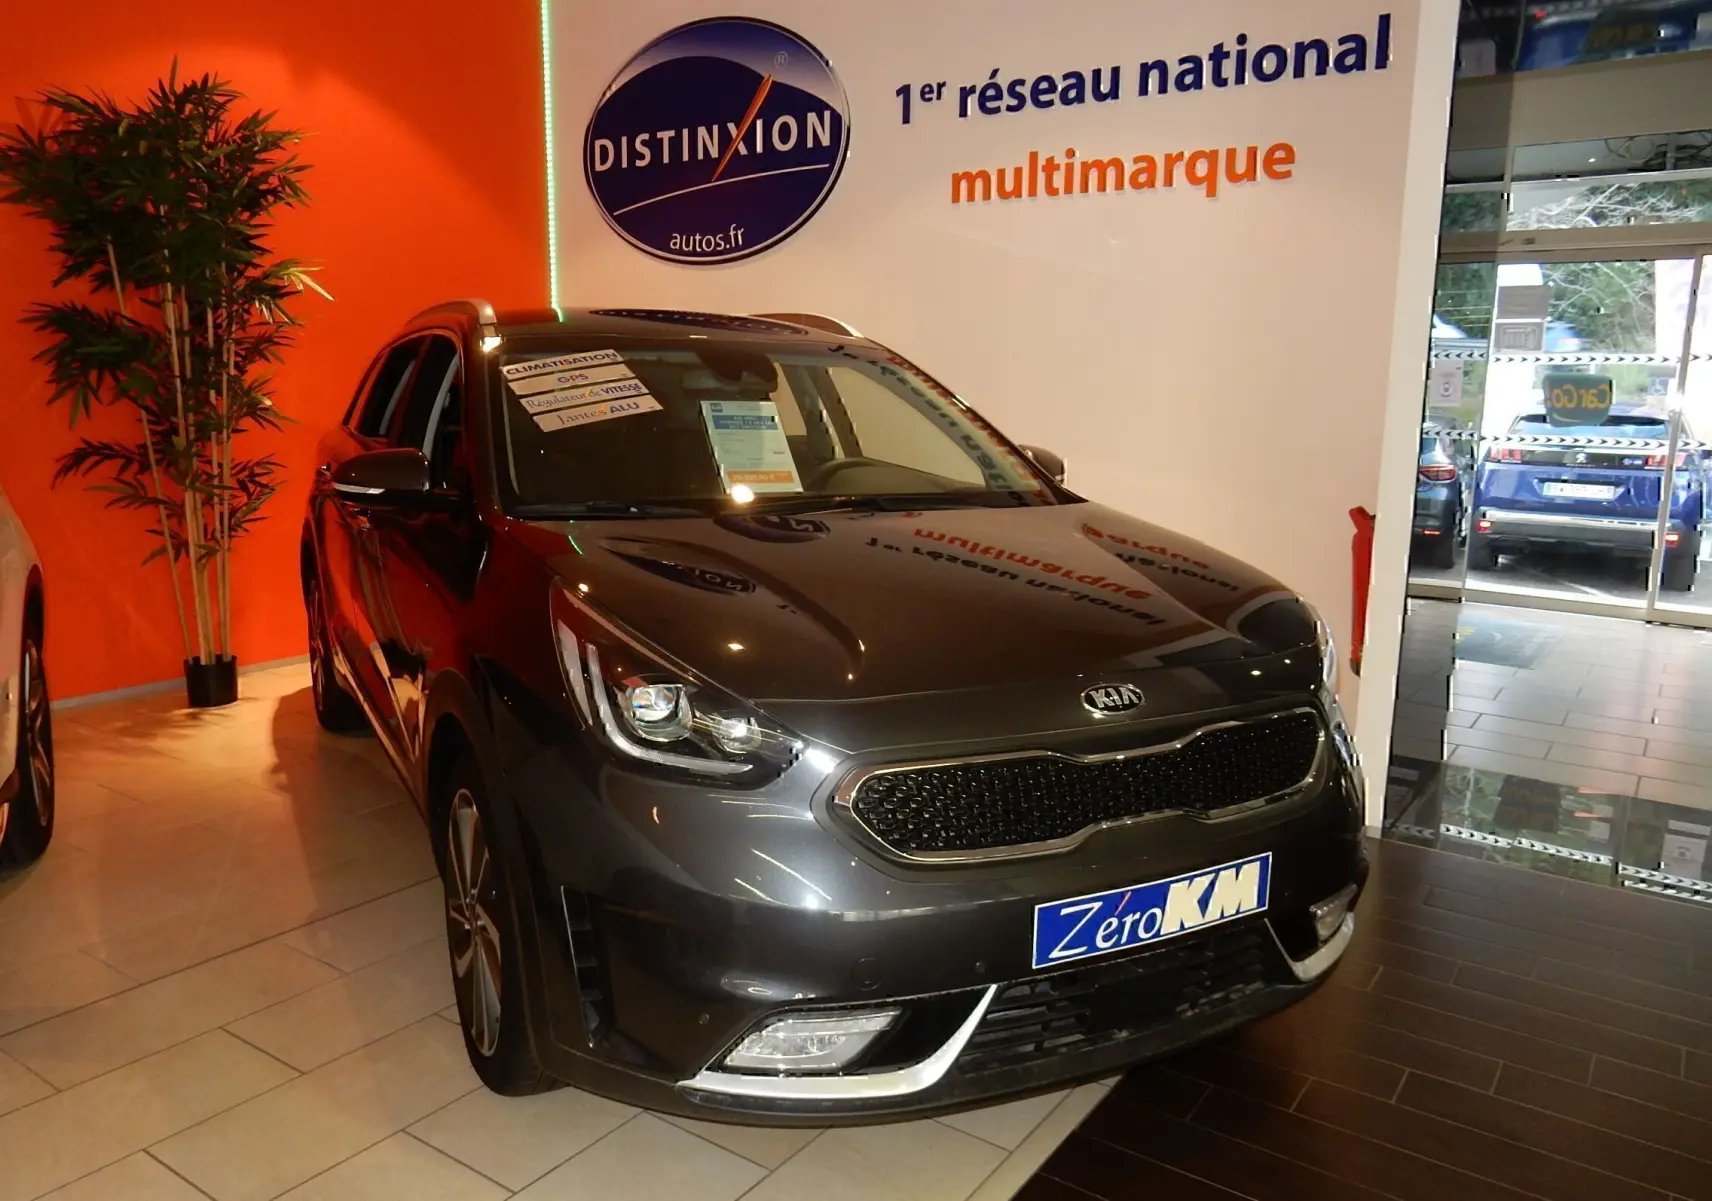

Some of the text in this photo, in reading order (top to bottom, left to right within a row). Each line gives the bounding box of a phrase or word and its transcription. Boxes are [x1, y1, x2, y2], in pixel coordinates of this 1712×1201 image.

[958, 68, 1121, 118] réseau
[1138, 13, 1393, 97] national
[594, 109, 831, 172] DISTINXION
[951, 140, 1297, 204] multimarque
[670, 223, 745, 252] autos.fr
[506, 352, 618, 375] CLIMATISATION
[557, 373, 589, 384] GPS
[526, 391, 587, 409] Régulateur
[600, 382, 643, 395] VITESSE
[556, 401, 640, 426] Jantes ALU
[1088, 686, 1140, 709] KIA
